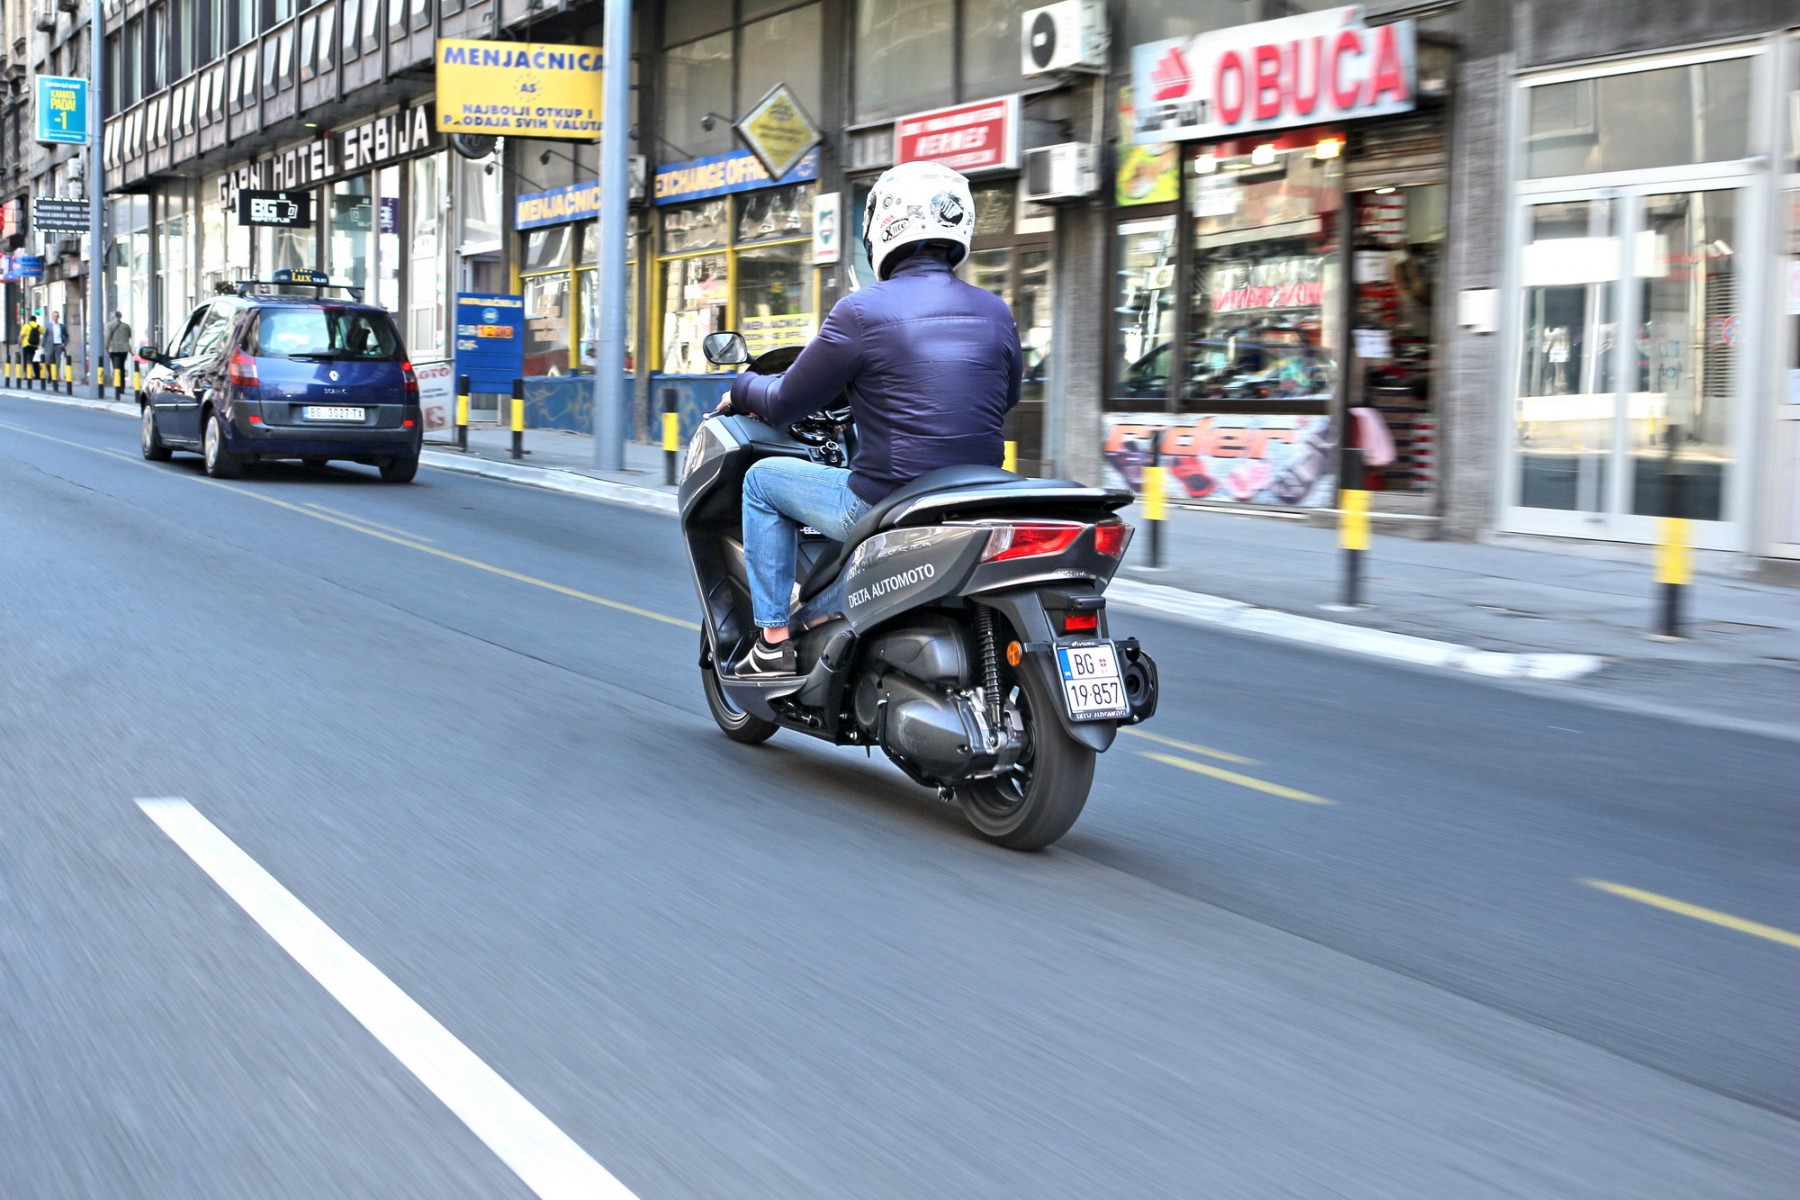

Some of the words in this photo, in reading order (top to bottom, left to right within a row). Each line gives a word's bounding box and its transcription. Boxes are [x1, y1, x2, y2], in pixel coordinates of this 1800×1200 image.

[443, 46, 604, 72] MENJAČNICA
[1217, 9, 1408, 126] OBUĆA
[520, 83, 537, 93] AS
[443, 115, 510, 128] PODAJA
[515, 117, 548, 129] SVIH
[462, 104, 530, 117] NAJBOLJI
[535, 107, 583, 118] OTKUP
[588, 110, 594, 119] I
[273, 138, 335, 191] HOTEL
[344, 105, 430, 171] SRBIJA
[655, 164, 727, 199] EXCHANGE
[251, 199, 277, 217] BG
[517, 186, 600, 222] MENJAČNIC
[291, 271, 313, 282] Lux
[415, 367, 450, 381] OTO
[1104, 415, 1297, 459] rder
[848, 587, 871, 609] DELTA
[872, 563, 935, 599] AUTOMOTO
[1074, 653, 1095, 676] BG
